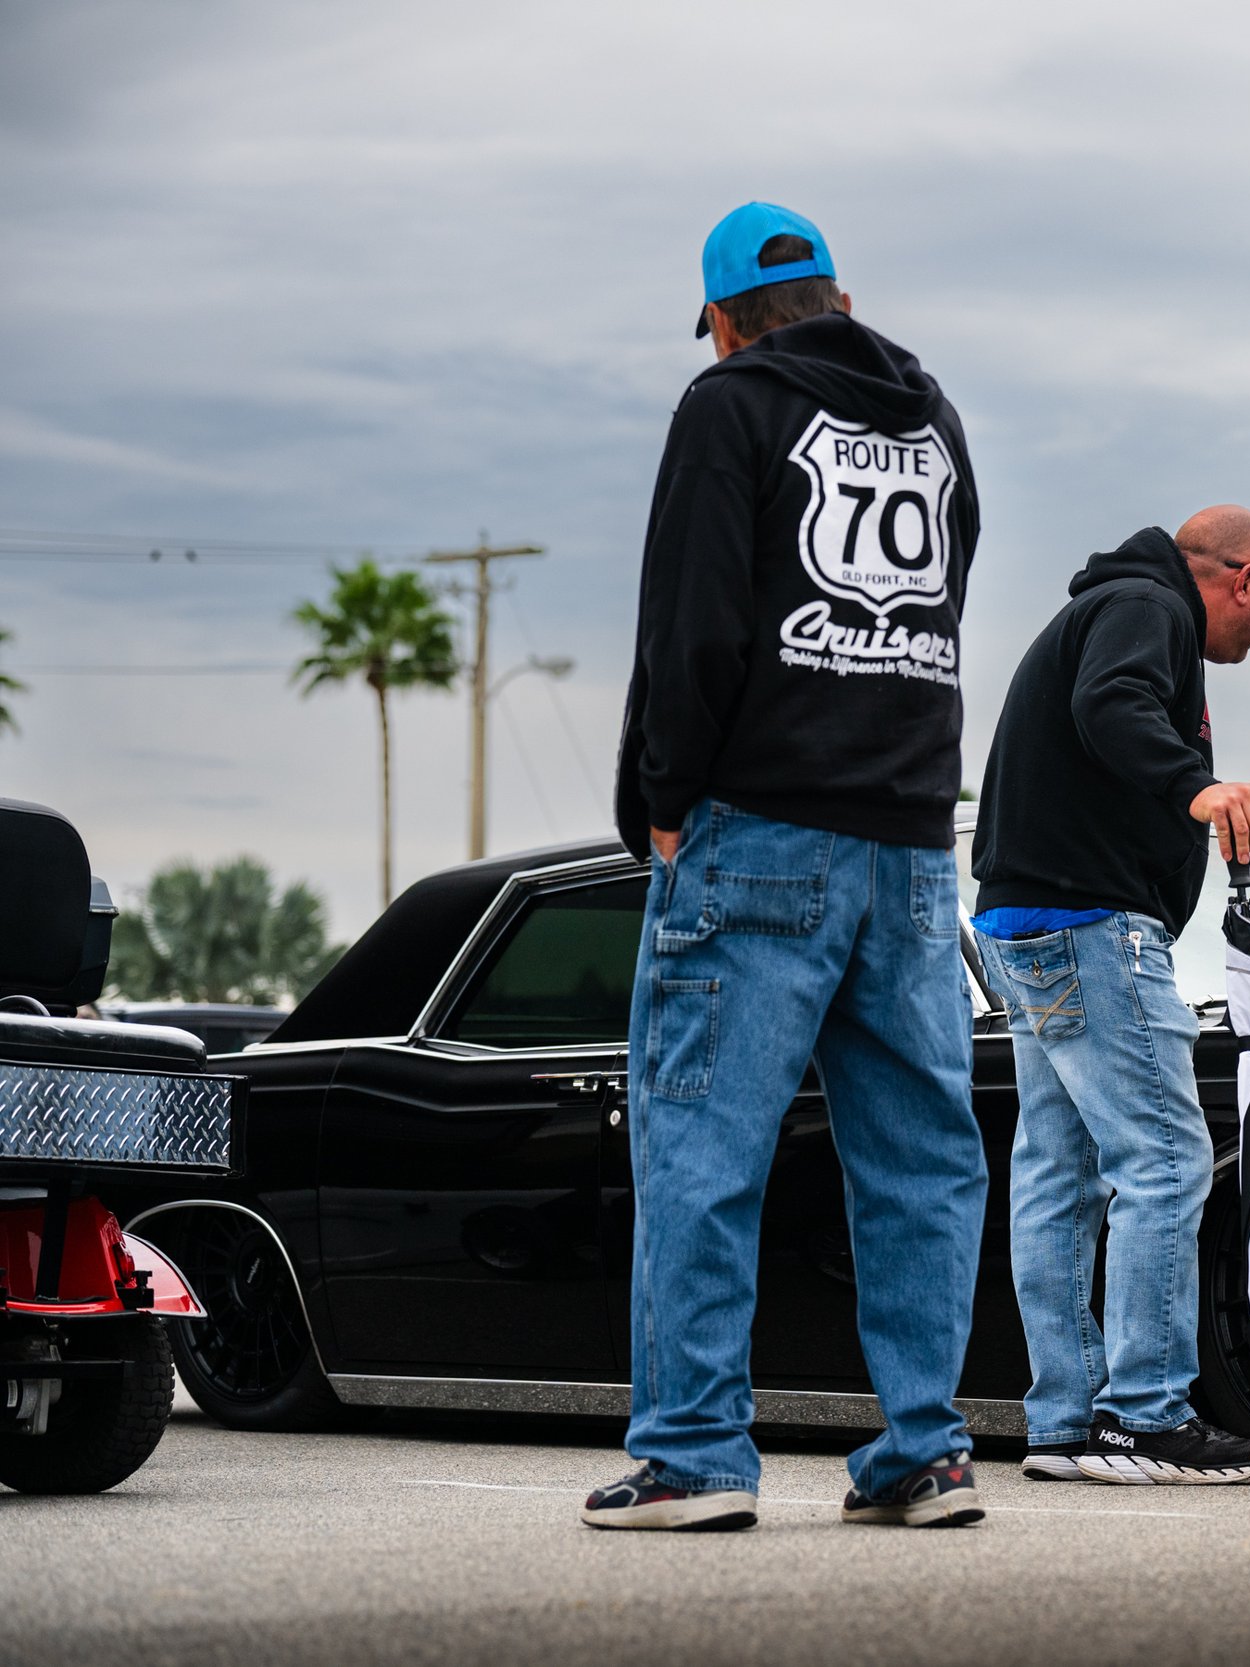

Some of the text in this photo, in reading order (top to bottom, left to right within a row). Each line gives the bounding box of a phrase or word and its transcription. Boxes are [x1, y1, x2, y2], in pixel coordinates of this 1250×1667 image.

[834, 439, 929, 477] ROUTE
[837, 482, 933, 571] 70
[842, 570, 927, 587] OLD FORT, NC
[780, 600, 956, 668] Cruisers
[1098, 1428, 1135, 1449] HOKA
